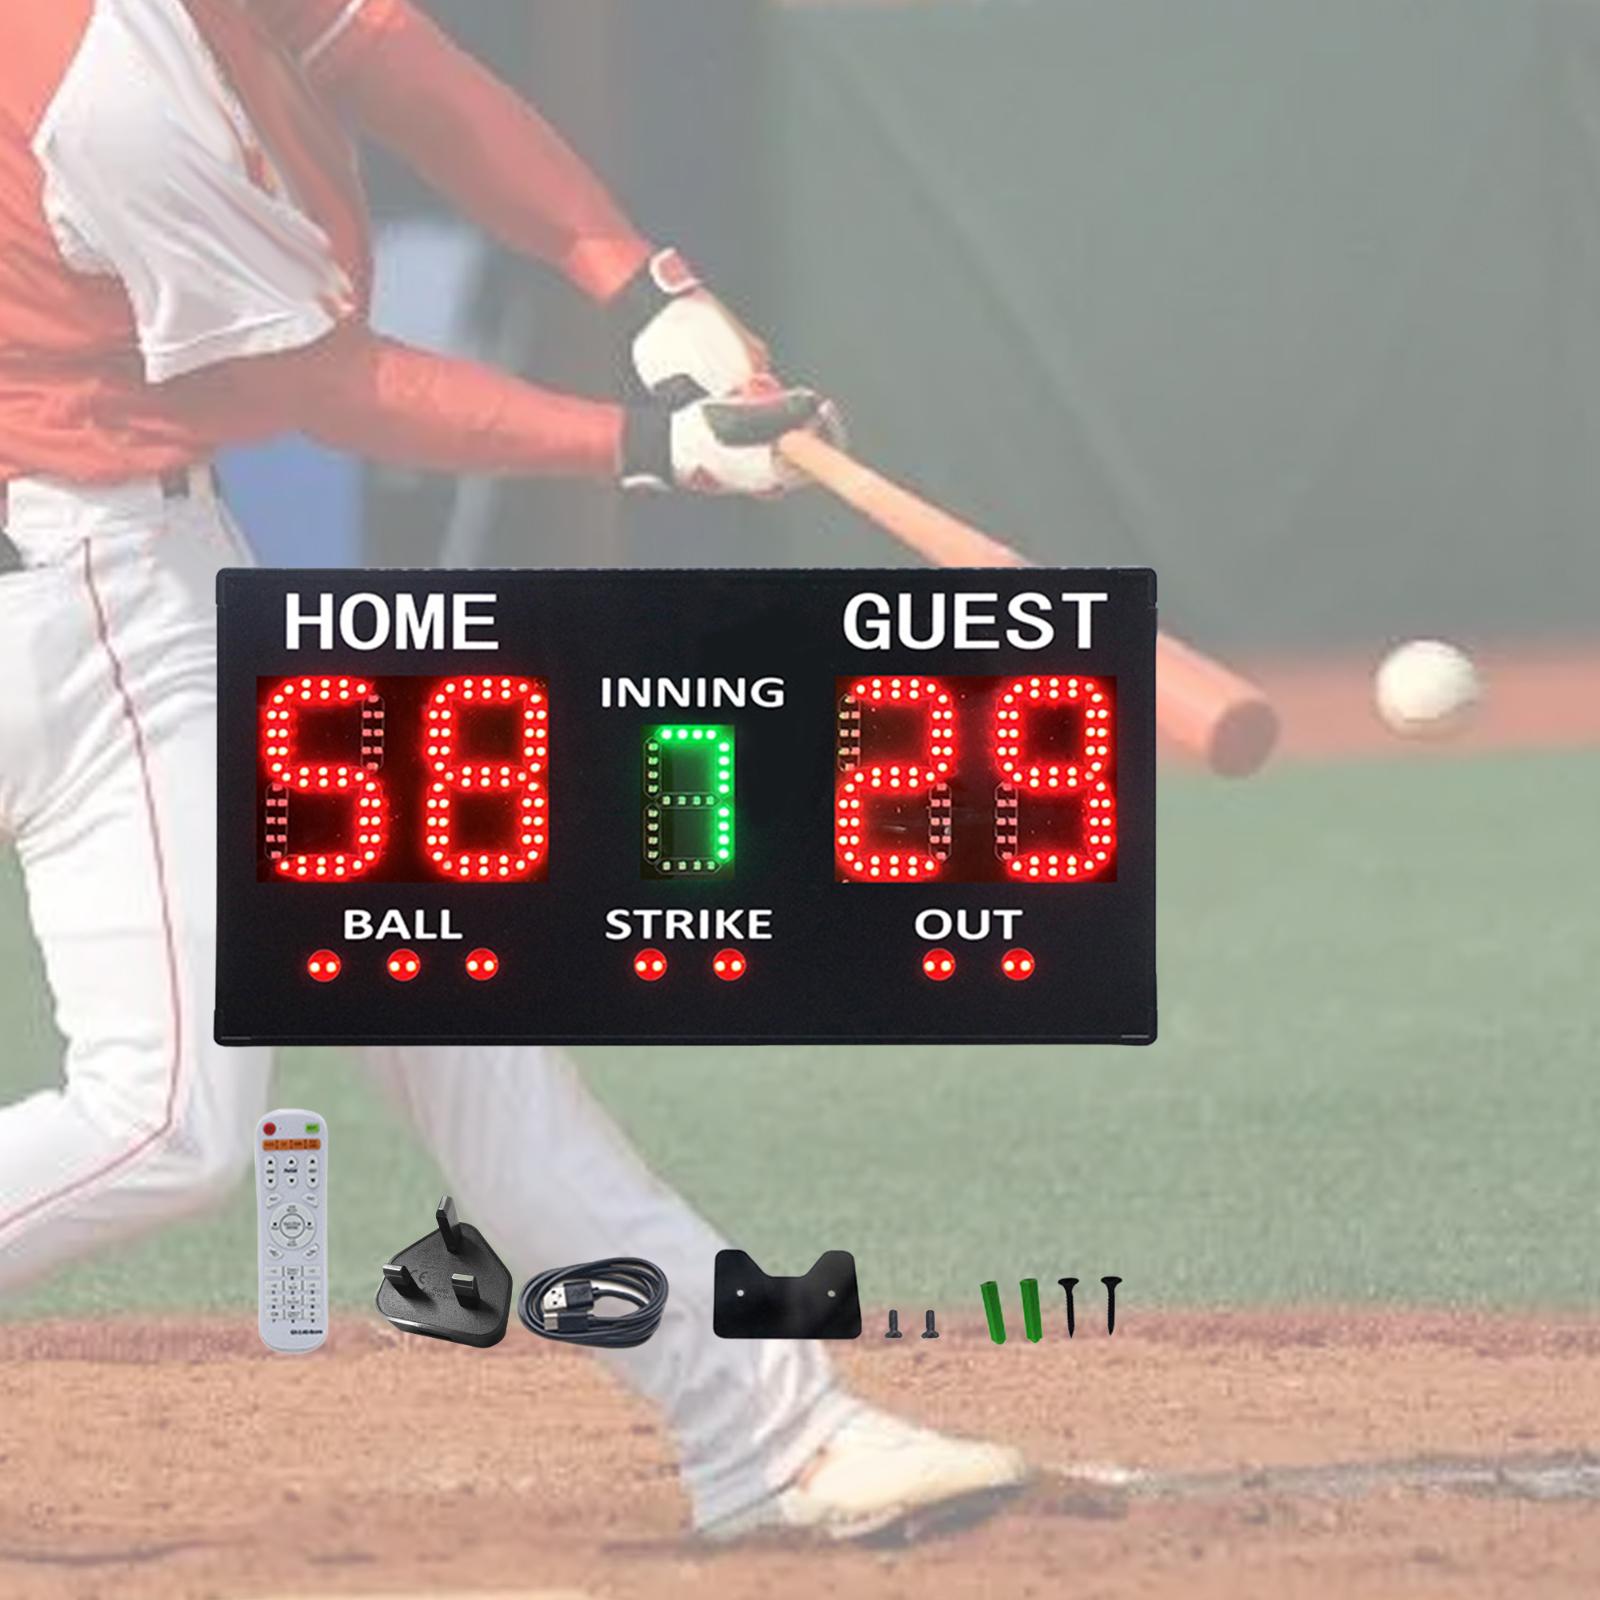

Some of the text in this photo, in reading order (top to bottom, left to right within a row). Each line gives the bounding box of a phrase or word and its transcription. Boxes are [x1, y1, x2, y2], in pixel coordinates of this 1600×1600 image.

[286, 592, 499, 651] HOME
[843, 592, 1108, 650] GUEST
[601, 677, 784, 708] INNING
[262, 676, 548, 882] 58
[655, 725, 734, 862] 7
[836, 676, 1116, 882] 29
[344, 909, 463, 940] BALL
[605, 909, 773, 940] STRIKE
[915, 908, 1024, 941] OUT
